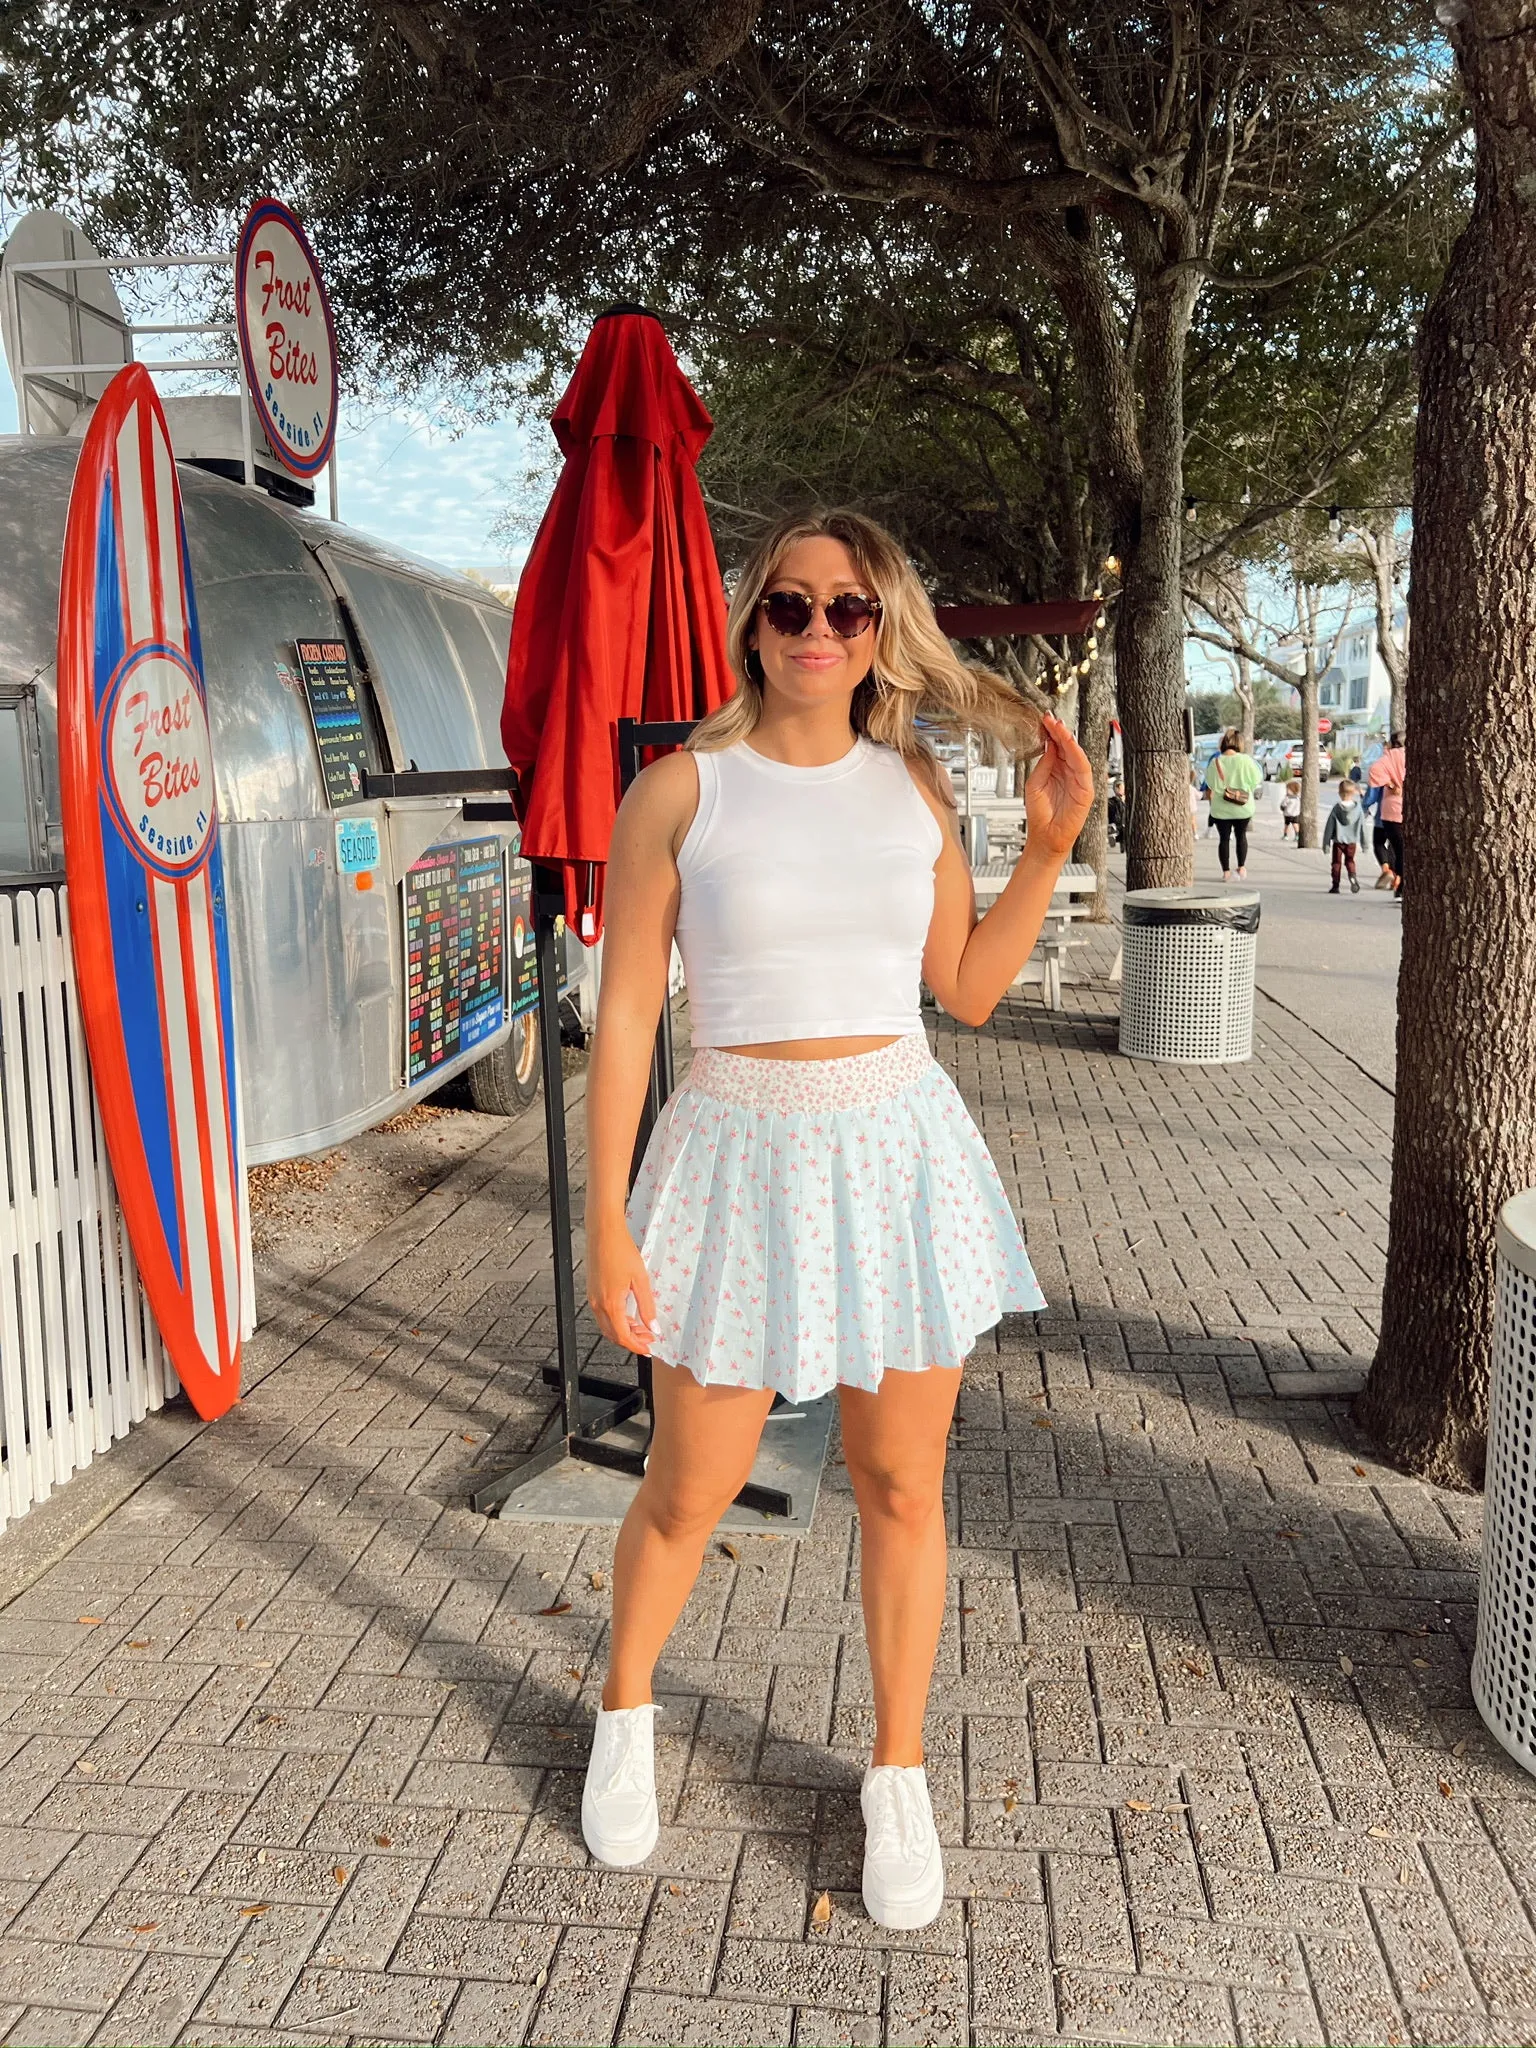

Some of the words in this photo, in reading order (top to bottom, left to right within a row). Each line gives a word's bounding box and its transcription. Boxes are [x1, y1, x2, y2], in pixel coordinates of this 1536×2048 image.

[255, 250, 311, 317] Frost
[265, 322, 318, 385] Bites
[125, 688, 191, 757] Frost
[139, 751, 200, 807] Bites
[340, 836, 377, 864] SEASIDE
